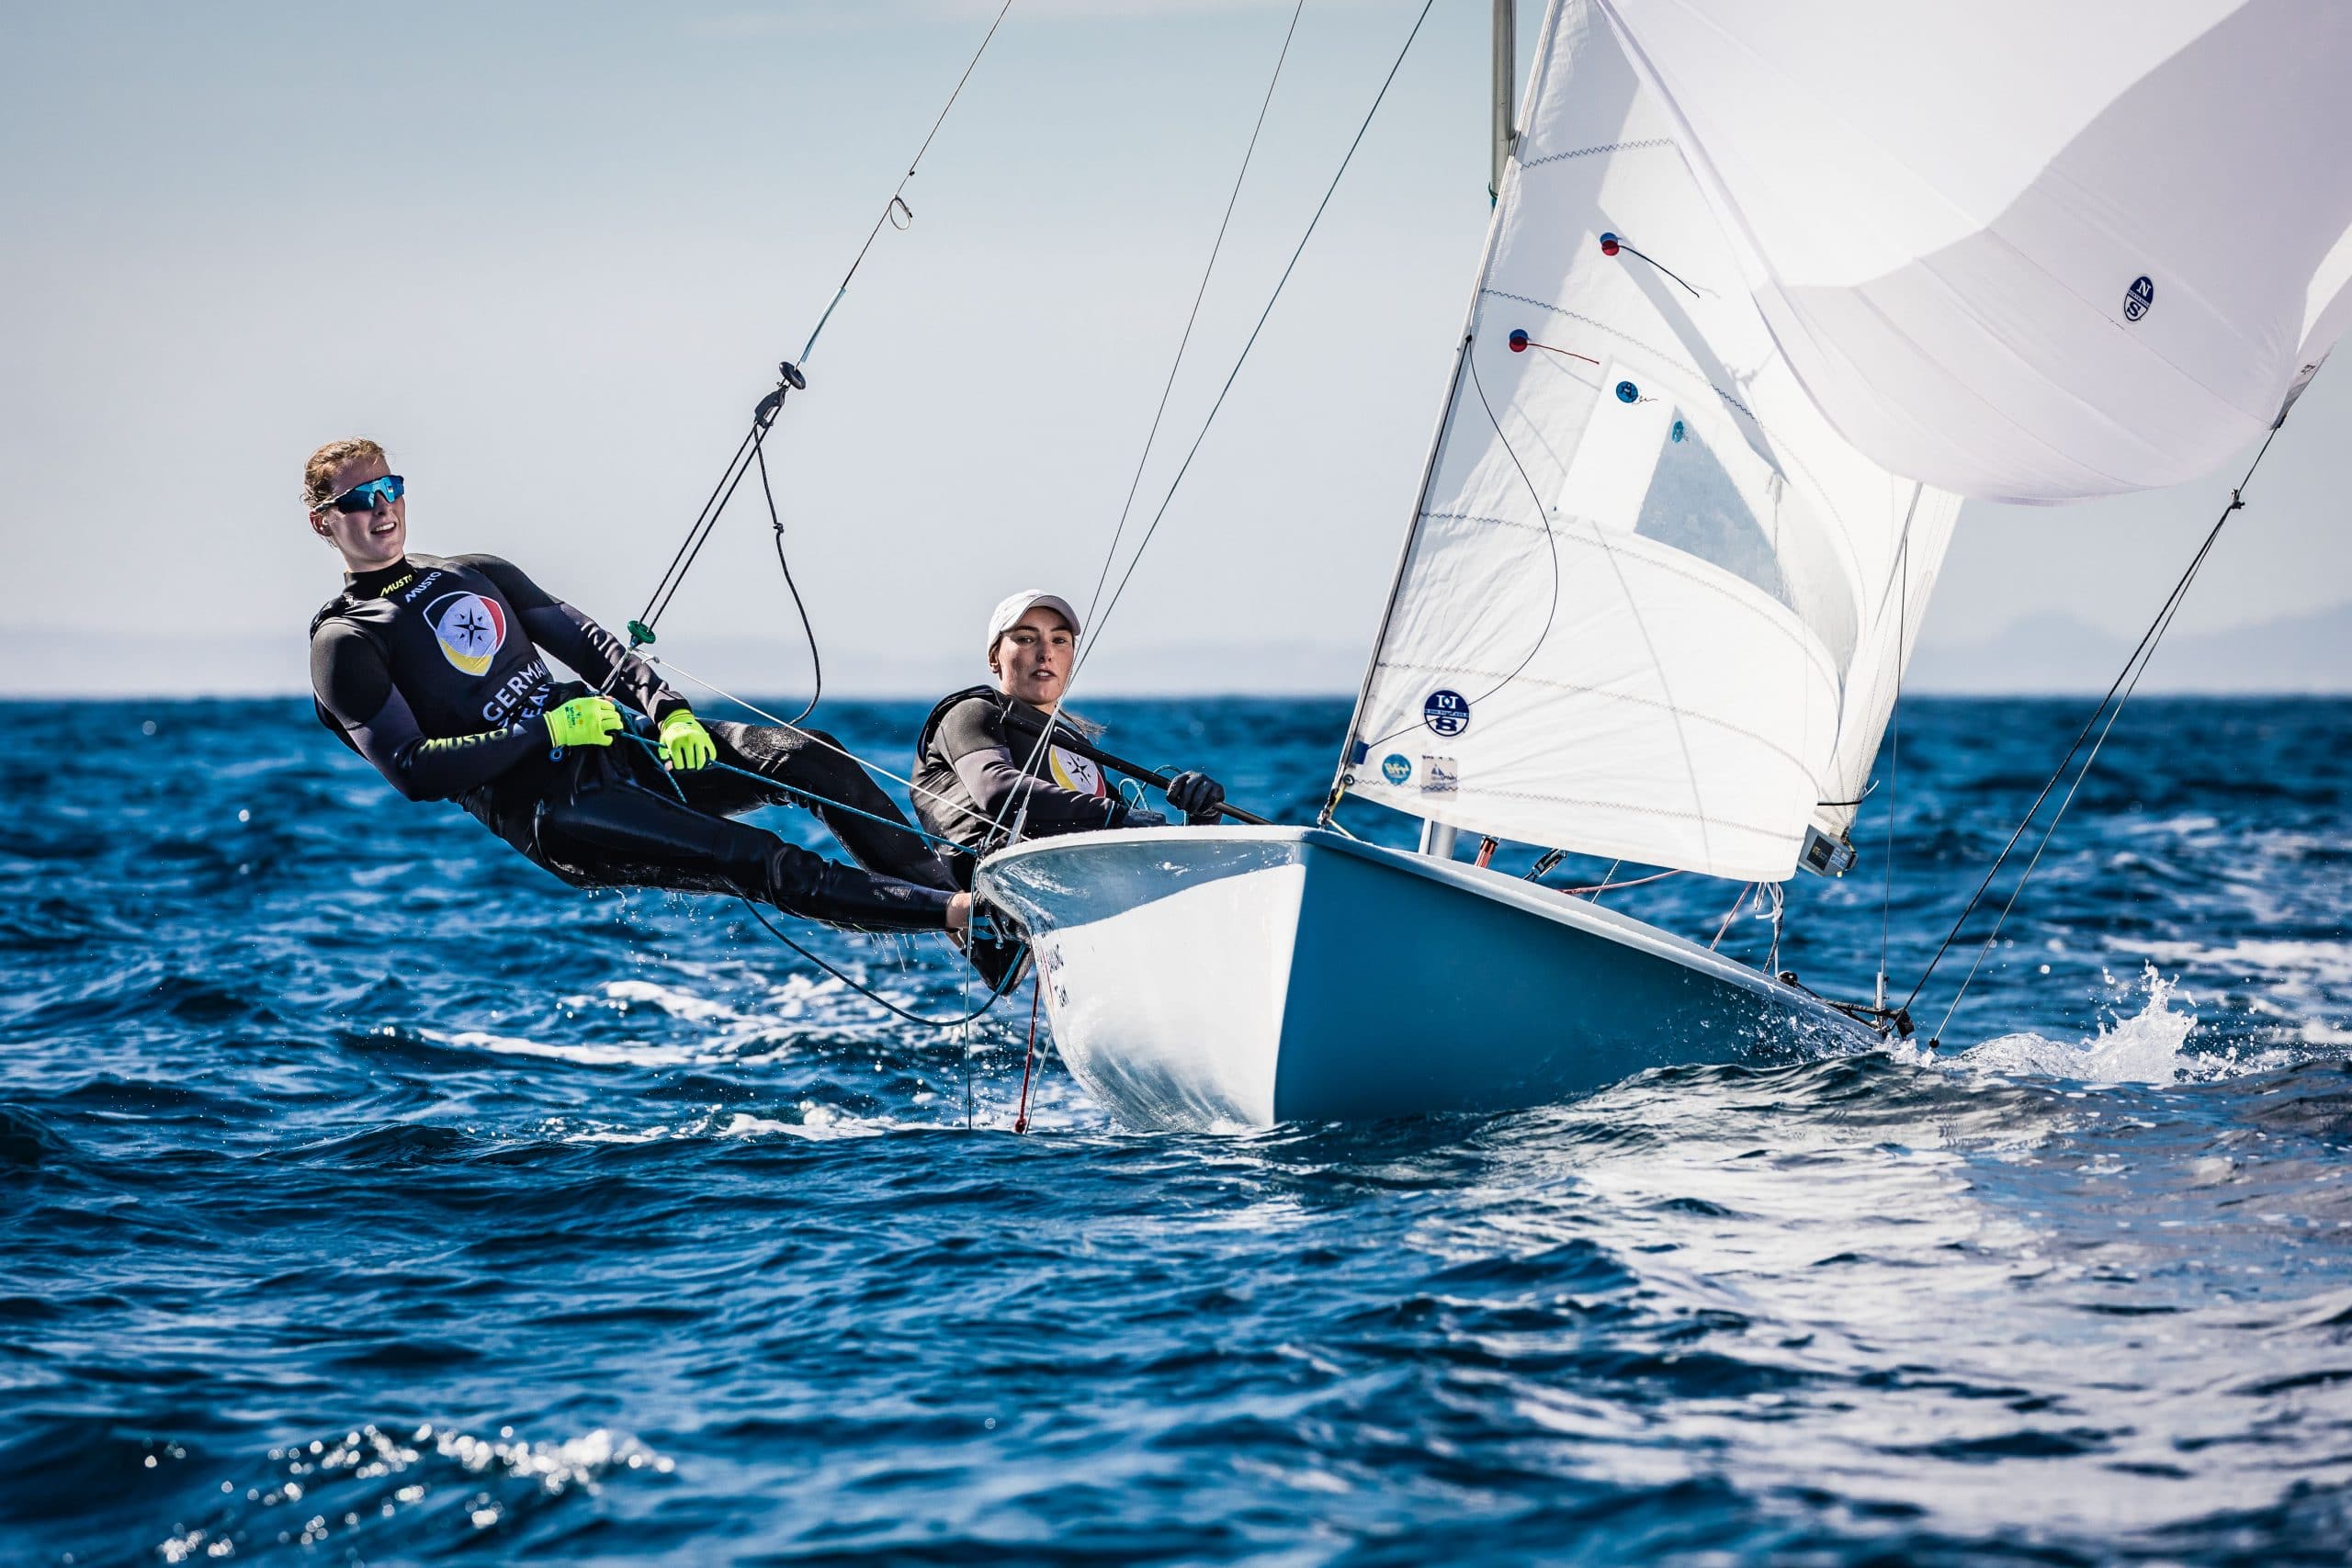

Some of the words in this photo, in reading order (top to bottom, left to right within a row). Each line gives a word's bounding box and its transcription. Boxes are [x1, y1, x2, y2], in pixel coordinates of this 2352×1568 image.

[2136, 279, 2152, 297] N
[2127, 301, 2142, 317] S
[379, 574, 413, 597] MUSTO
[405, 571, 442, 603] MUSTO
[418, 728, 508, 754] MUSTO
